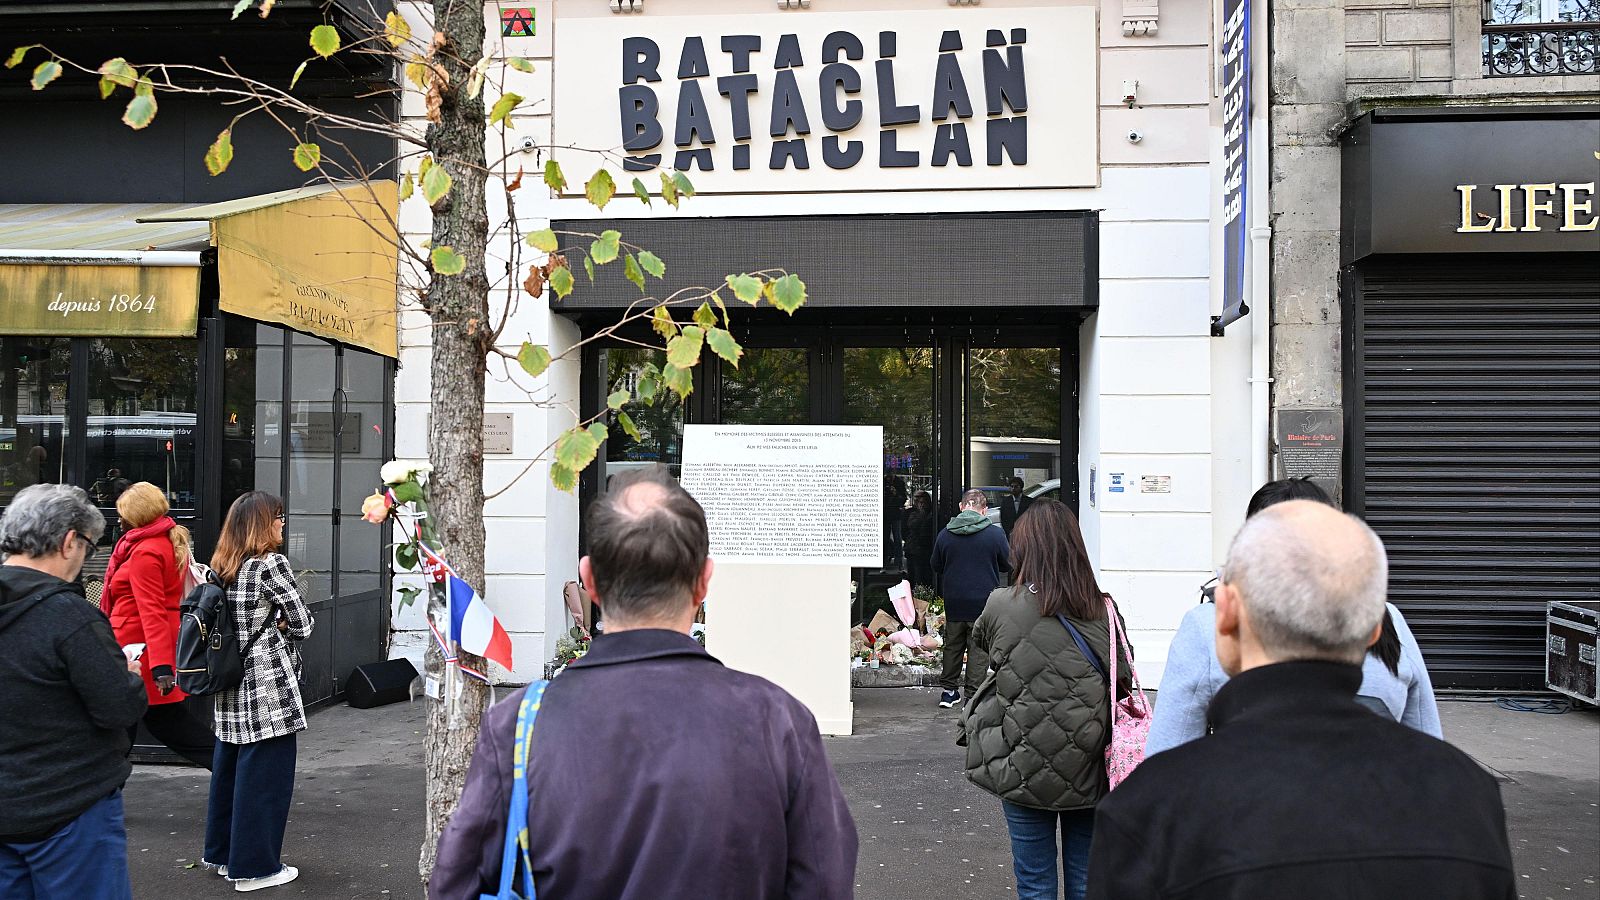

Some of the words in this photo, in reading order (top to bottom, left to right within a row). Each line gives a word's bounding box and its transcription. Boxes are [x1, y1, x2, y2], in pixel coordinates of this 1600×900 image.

[619, 46, 1028, 152] BATACLAN
[1457, 182, 1599, 232] LIFE
[47, 292, 101, 317] depuis
[108, 293, 156, 314] 1864
